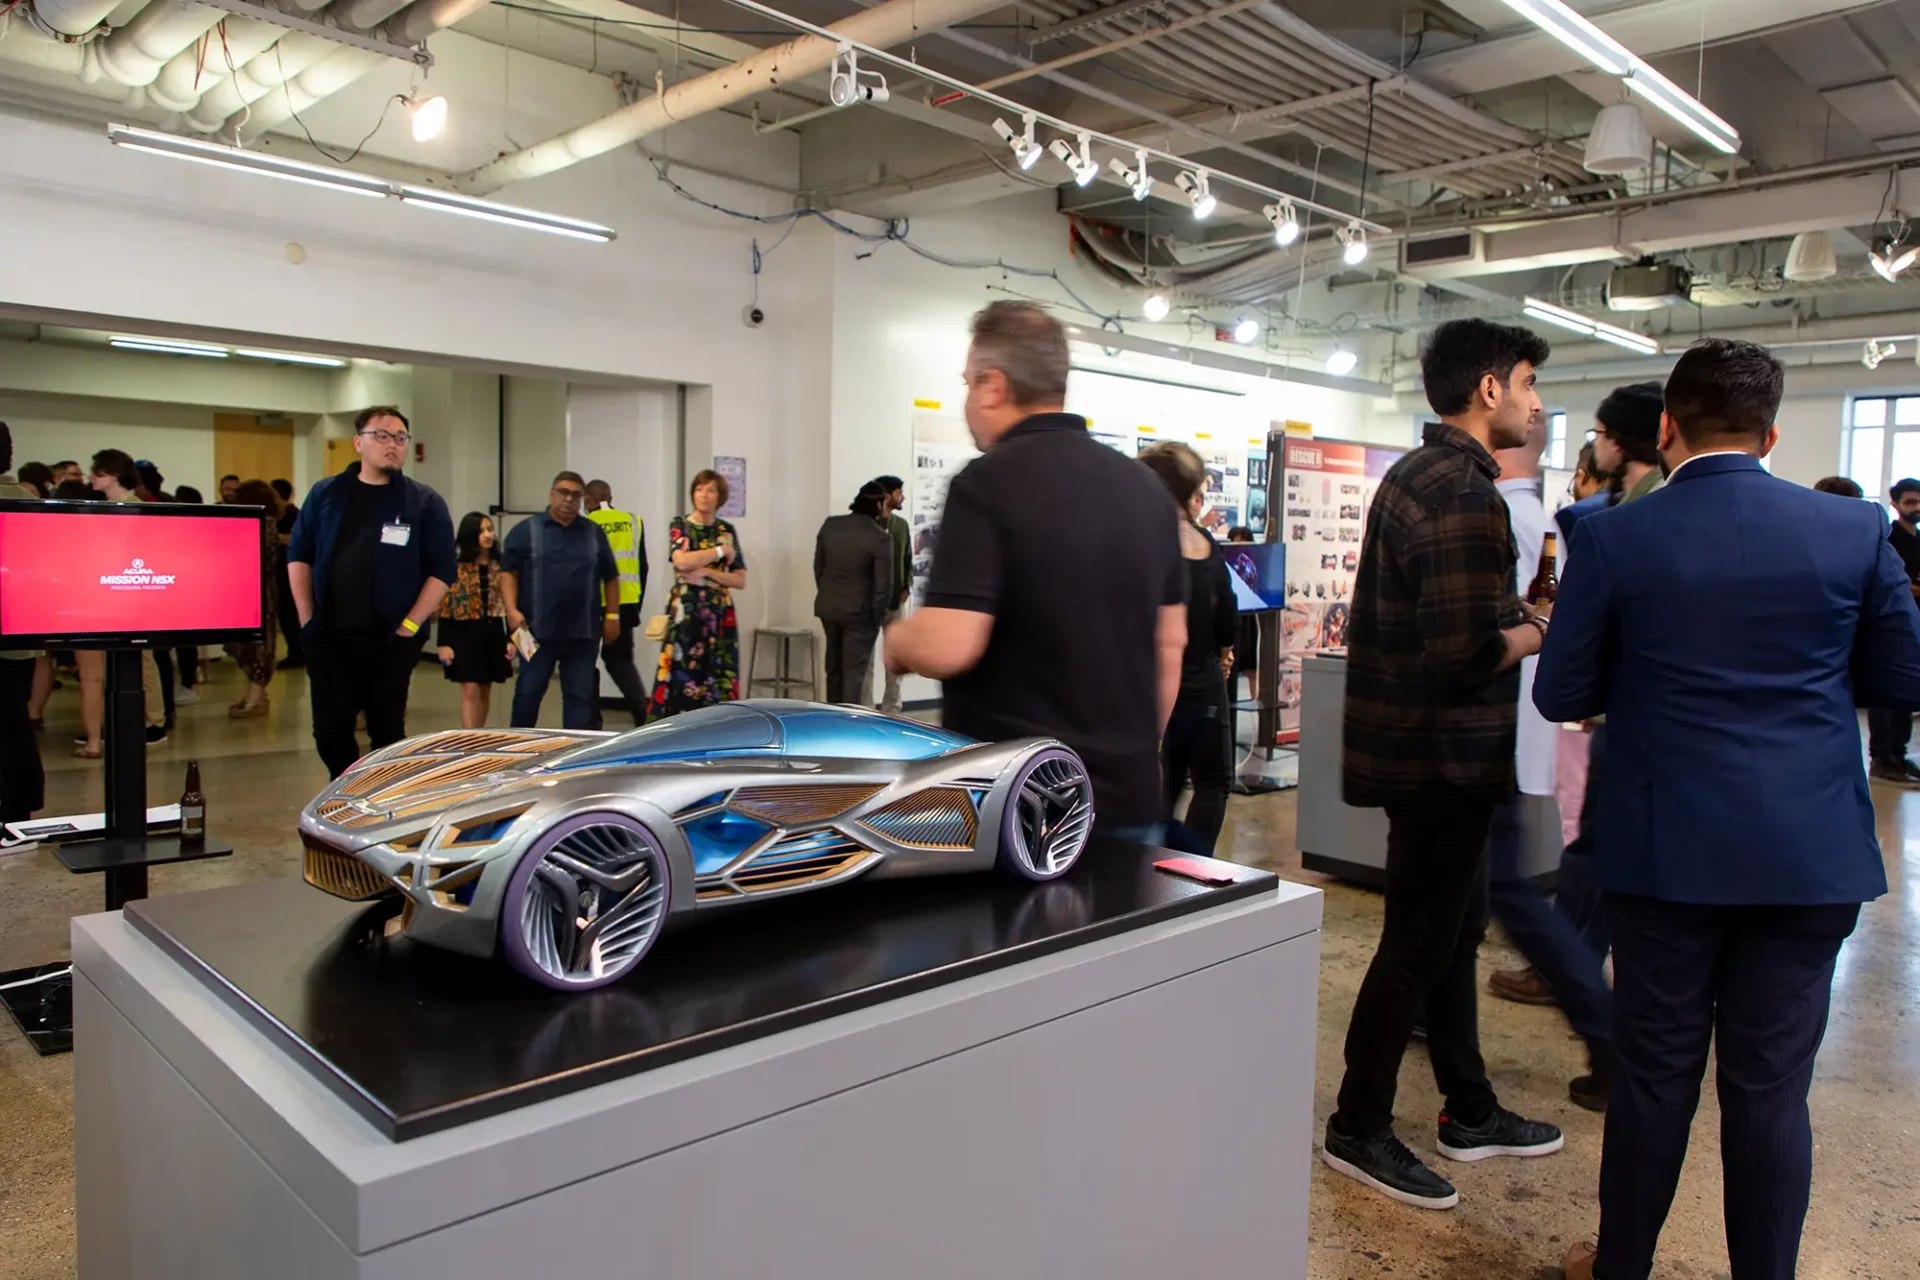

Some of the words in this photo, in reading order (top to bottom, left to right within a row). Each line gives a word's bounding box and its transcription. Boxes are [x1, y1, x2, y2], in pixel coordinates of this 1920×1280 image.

[600, 521, 632, 534] CURITY
[100, 575, 150, 584] MISSION
[151, 575, 176, 584] NSX
